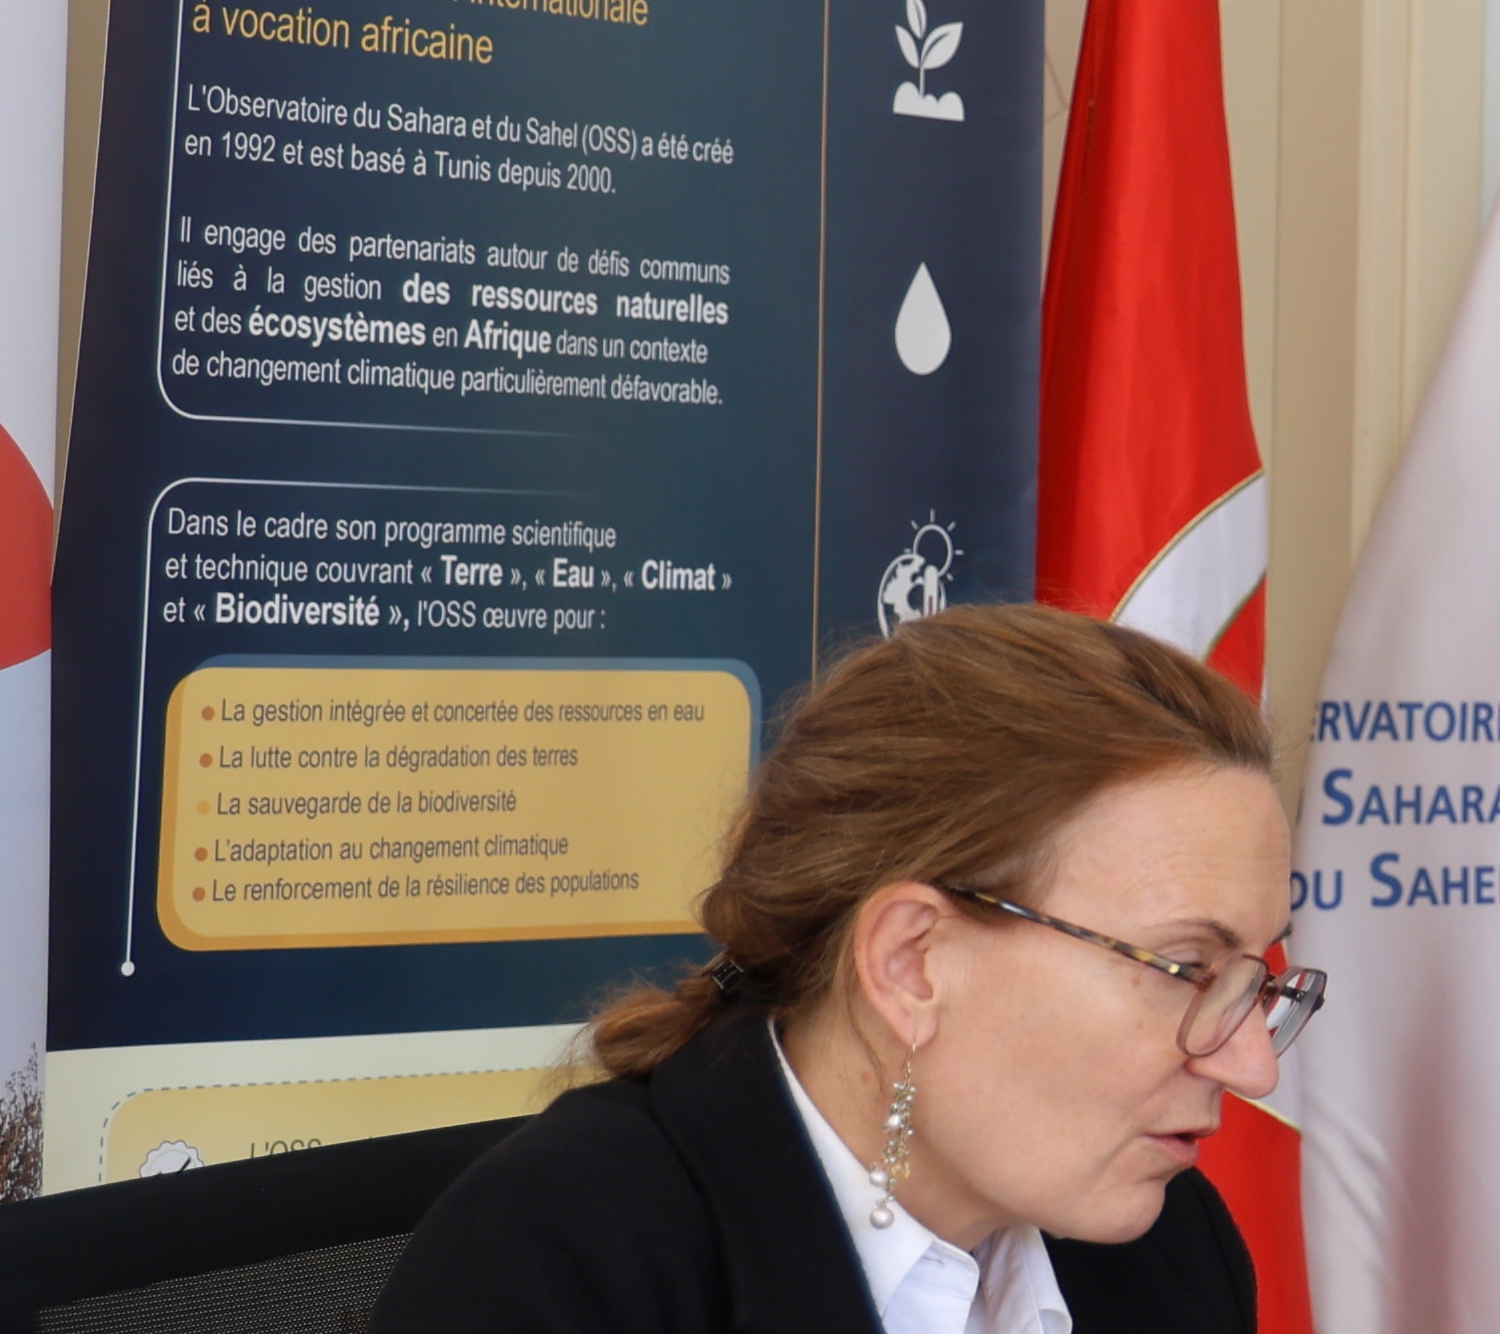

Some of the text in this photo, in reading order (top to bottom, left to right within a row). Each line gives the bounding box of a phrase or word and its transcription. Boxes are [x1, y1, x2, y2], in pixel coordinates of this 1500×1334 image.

[221, 6, 350, 49] vocation
[360, 15, 493, 64] africaine
[187, 83, 734, 165] L'Observatoire du Sahara et du Sahel (OSS) a été créé
[184, 130, 616, 194] en 1992 et est basé à Tunis depuis 2000.
[180, 215, 730, 285] Il engage des partenariats autour de défis communs
[167, 506, 617, 553] Dans le cadre son programme scientifique
[164, 552, 716, 591] et technique couvrant Terre Eau Climat
[163, 591, 595, 635] et Biodiversité l'OSS œuvre pour
[221, 698, 705, 728] La gestion intégrée et concertée des ressources en eau
[212, 870, 639, 902] Le renforcement de la résilience des populations
